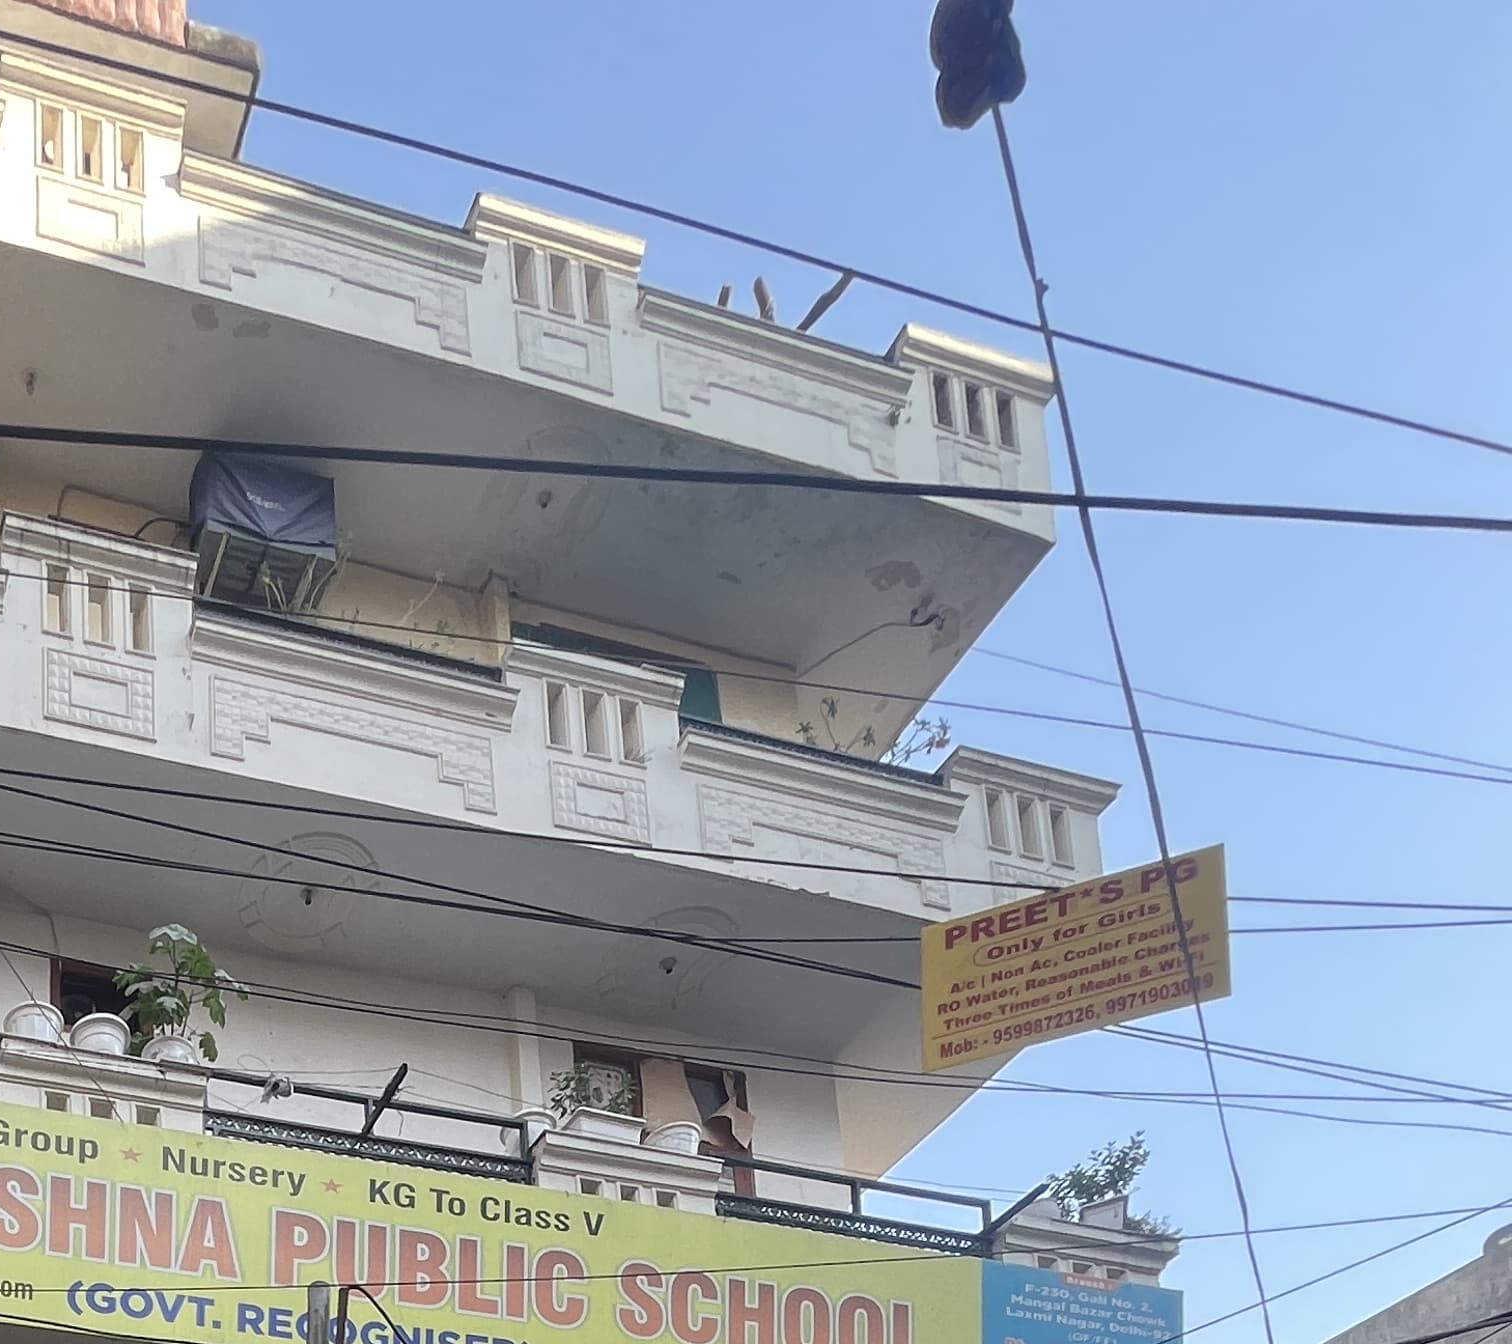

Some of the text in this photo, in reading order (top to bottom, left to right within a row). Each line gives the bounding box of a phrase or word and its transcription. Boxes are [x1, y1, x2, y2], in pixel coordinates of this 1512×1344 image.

[1140, 858, 1198, 894] PG
[987, 902, 1161, 960] Only for Girls
[938, 1001, 960, 1015] RO
[1026, 954, 1128, 990] Reasonable
[991, 967, 1024, 983] Non
[1064, 940, 1120, 962] Cooler
[944, 966, 1152, 1031] Three Times of Meals &
[162, 1146, 307, 1197] Nursery
[369, 1178, 416, 1209] KG
[429, 1188, 466, 1216] To
[480, 1197, 570, 1232] Class
[583, 1211, 605, 1236] V
[271, 1207, 589, 1329] PUBLIC
[67, 1280, 223, 1330] (GOVT.
[1006, 1307, 1052, 1321] Laxmi
[1070, 1304, 1113, 1318] Bazar
